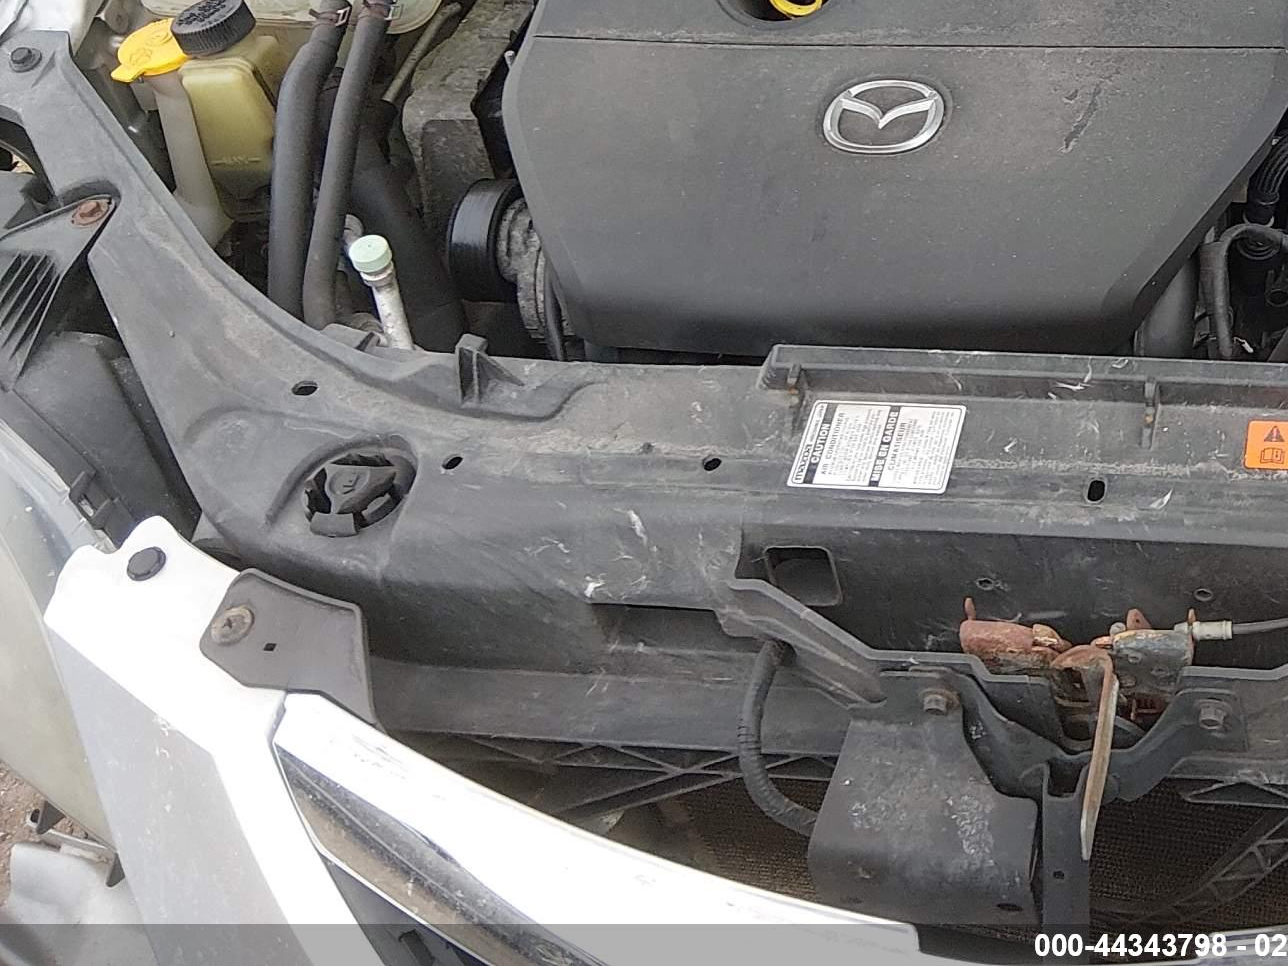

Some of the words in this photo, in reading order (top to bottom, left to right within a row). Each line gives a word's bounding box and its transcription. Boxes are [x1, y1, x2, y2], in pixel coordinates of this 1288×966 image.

[810, 423, 831, 464] CAUTION
[820, 462, 832, 475] AIR
[826, 412, 846, 459] CONDITIONER
[883, 411, 899, 443] GARDE
[877, 444, 890, 458] EN
[887, 422, 907, 471] CLIMATISEUR
[870, 458, 886, 481] MISE
